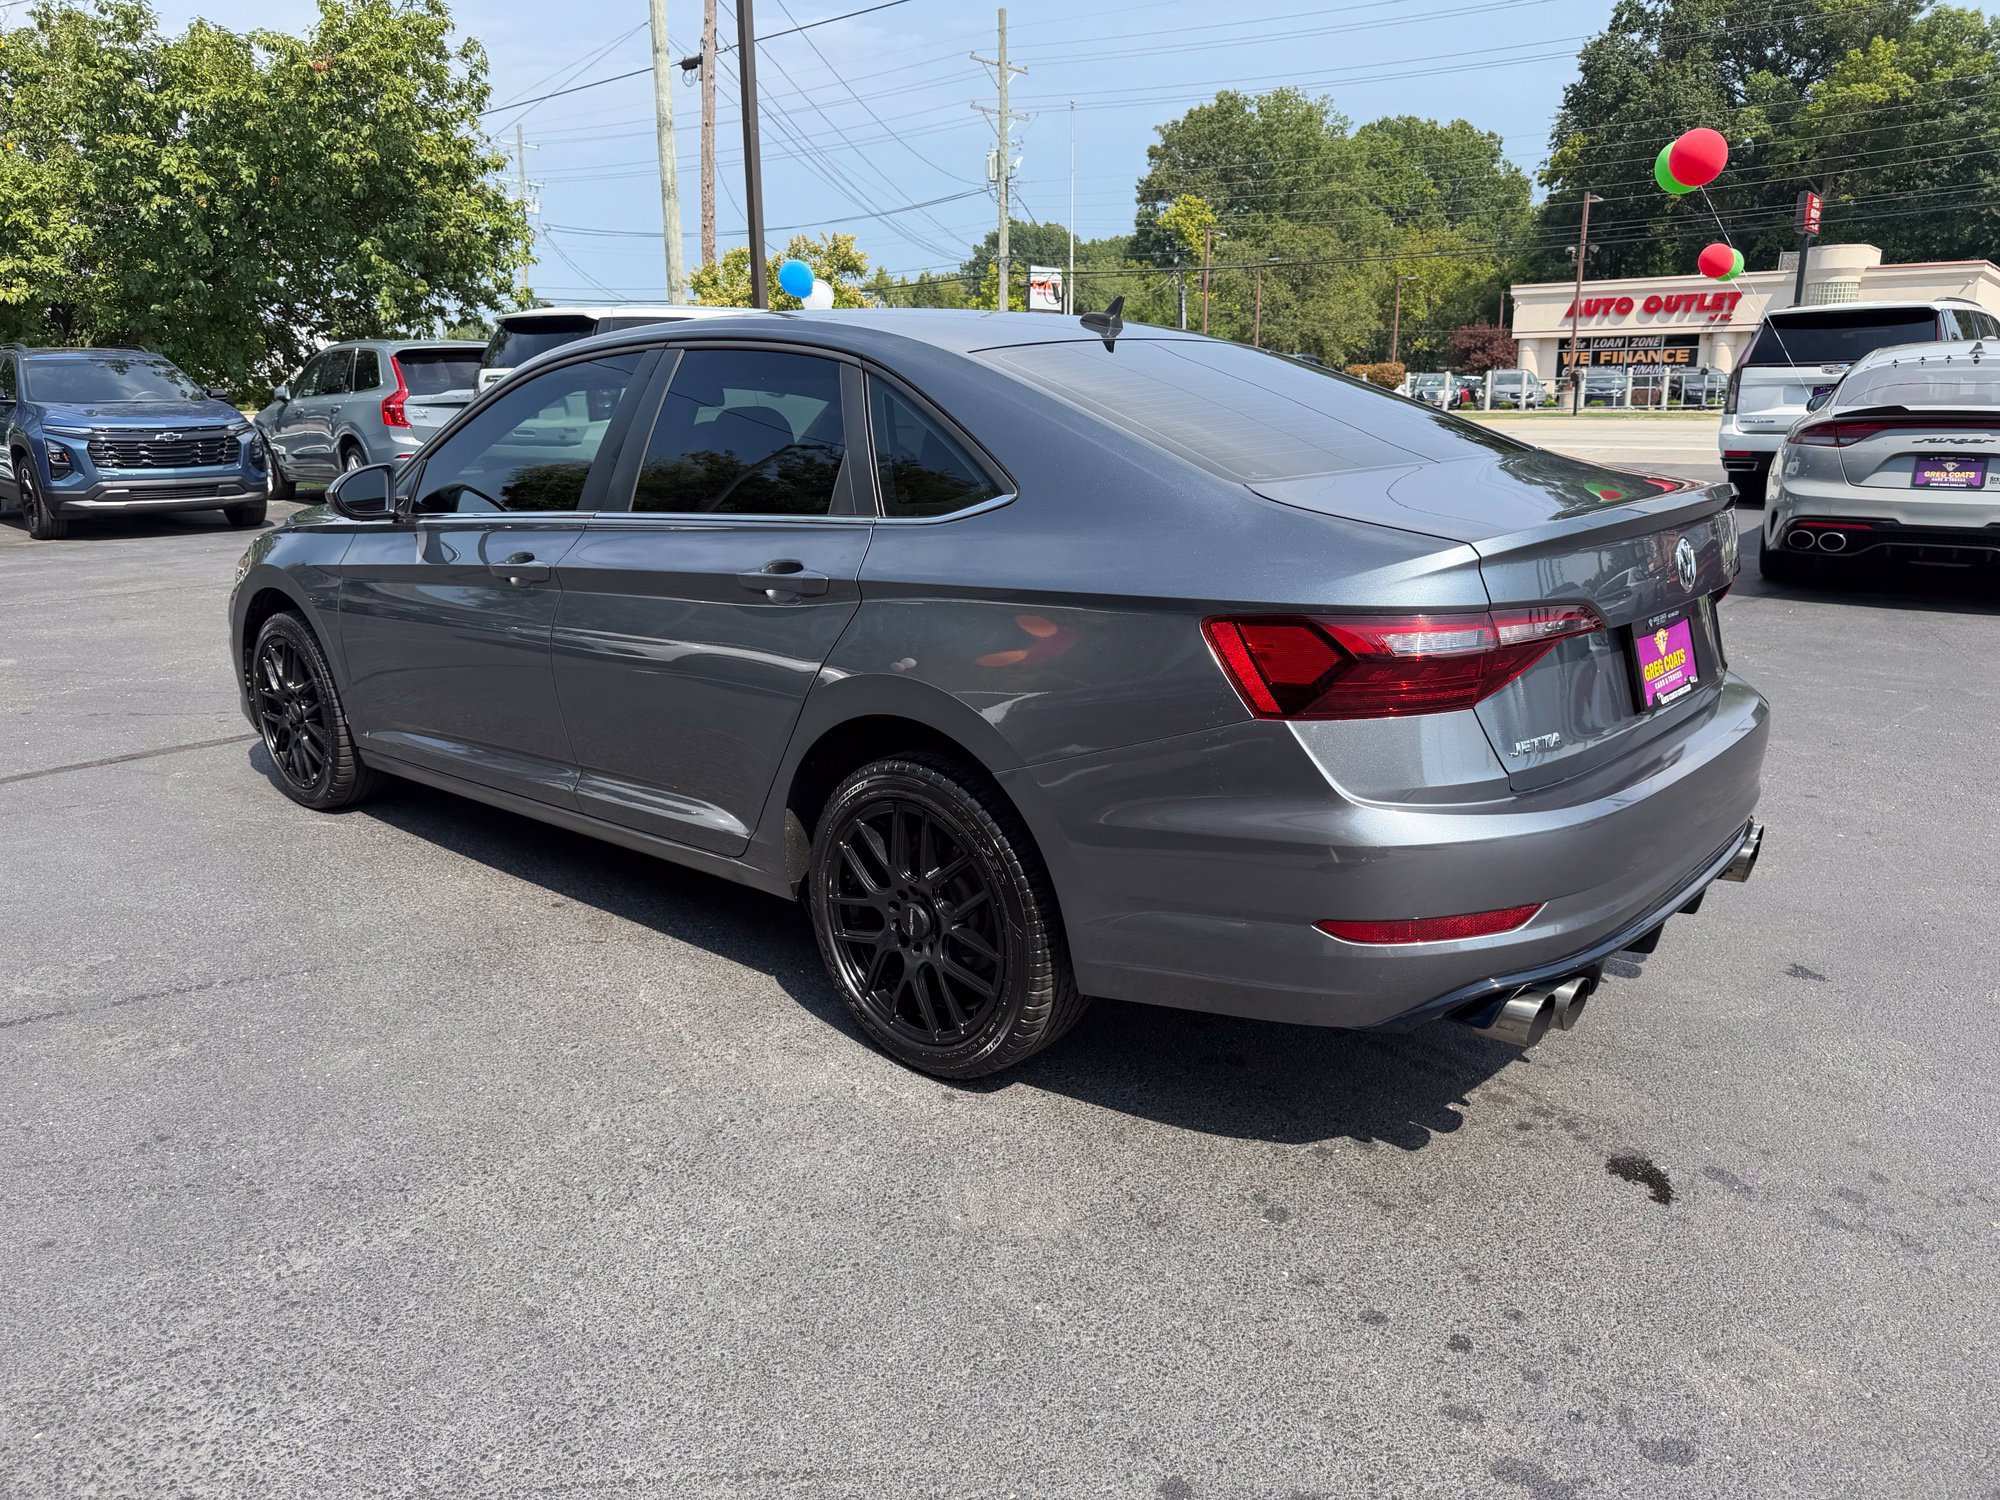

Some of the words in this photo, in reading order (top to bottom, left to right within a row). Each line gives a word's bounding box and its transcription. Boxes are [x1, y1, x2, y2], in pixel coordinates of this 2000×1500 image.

[1565, 297, 1634, 317] AUTO
[1641, 291, 1742, 314] OUTLET
[1593, 338, 1624, 348] LOAN
[1630, 336, 1661, 347] ZONE
[1562, 352, 1590, 365] WE
[1600, 349, 1690, 364] FINANCE
[1948, 471, 1976, 479] COATS
[1644, 658, 1664, 682] GREG
[1663, 648, 1686, 672] COATS
[1654, 679, 1665, 690] CARS
[1668, 670, 1683, 683] TRUCKS
[1509, 731, 1561, 757] JETTA
